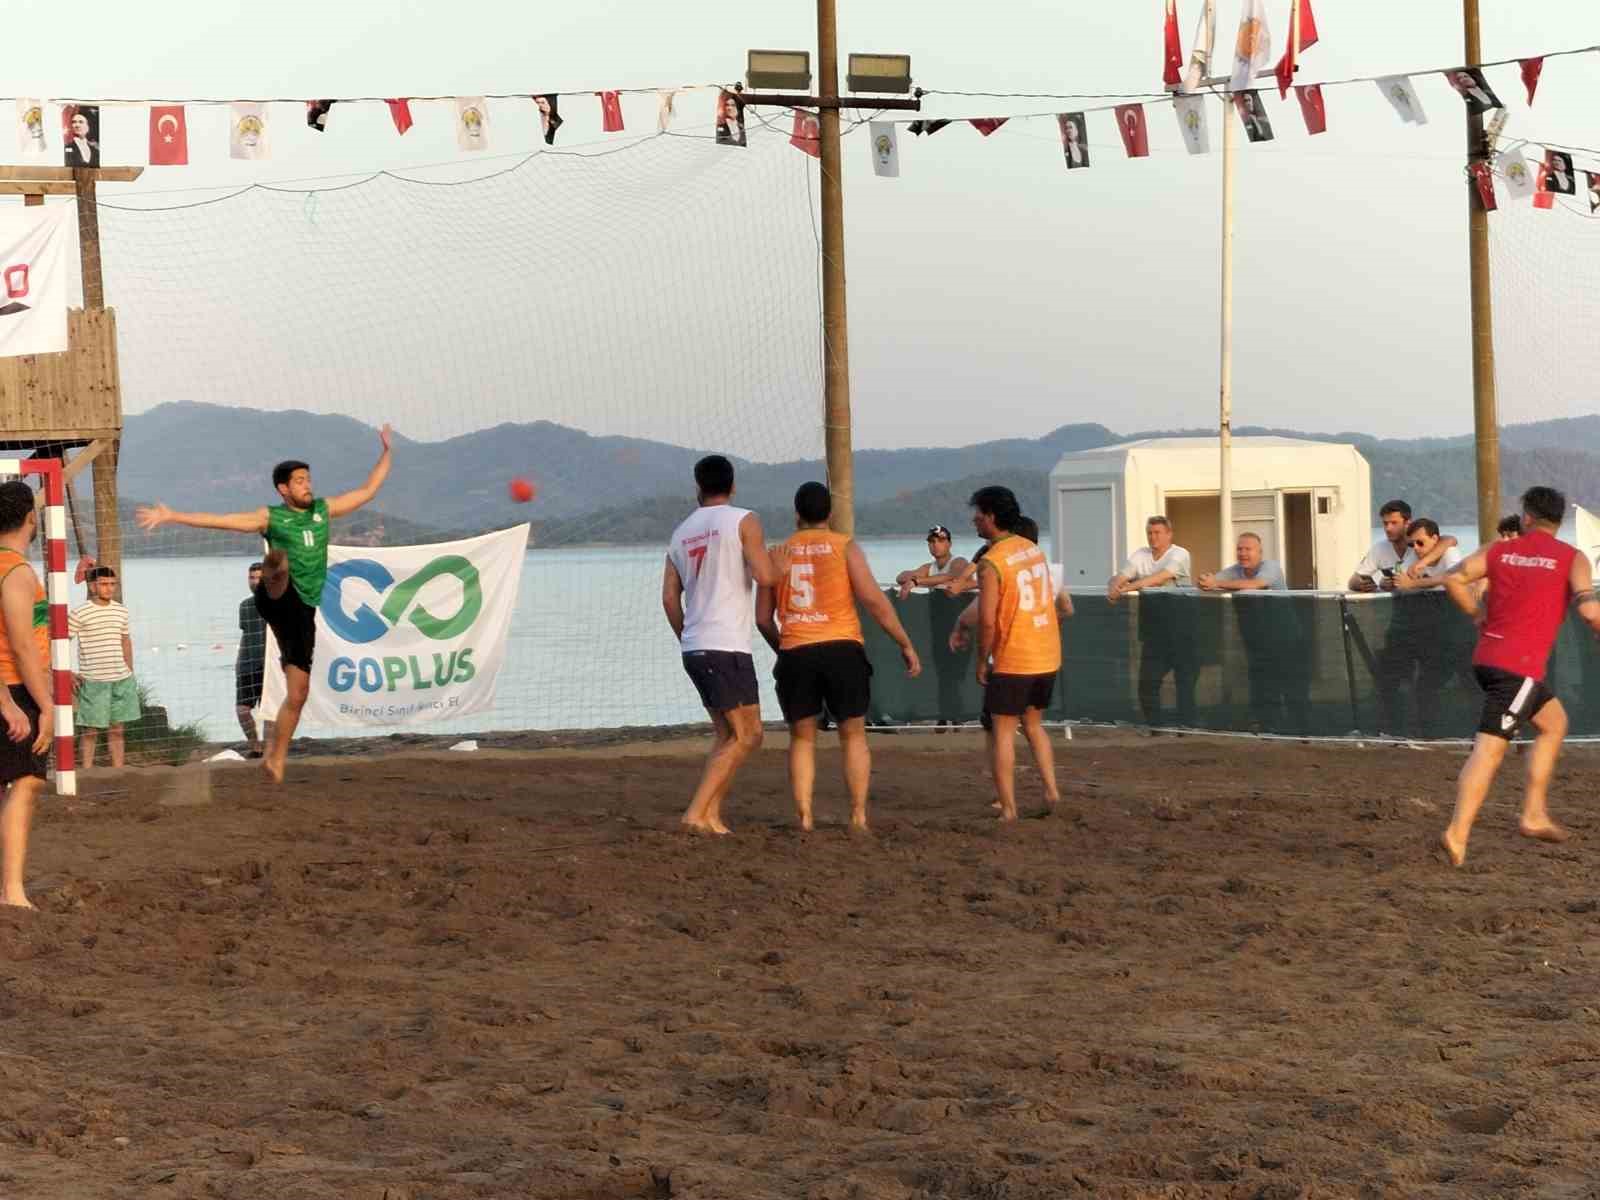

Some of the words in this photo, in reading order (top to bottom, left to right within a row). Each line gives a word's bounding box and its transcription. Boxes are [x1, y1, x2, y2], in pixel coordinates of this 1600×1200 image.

[303, 530, 314, 546] 11
[688, 544, 708, 576] 7
[790, 563, 816, 608] 5
[328, 648, 476, 692] GOPLUS
